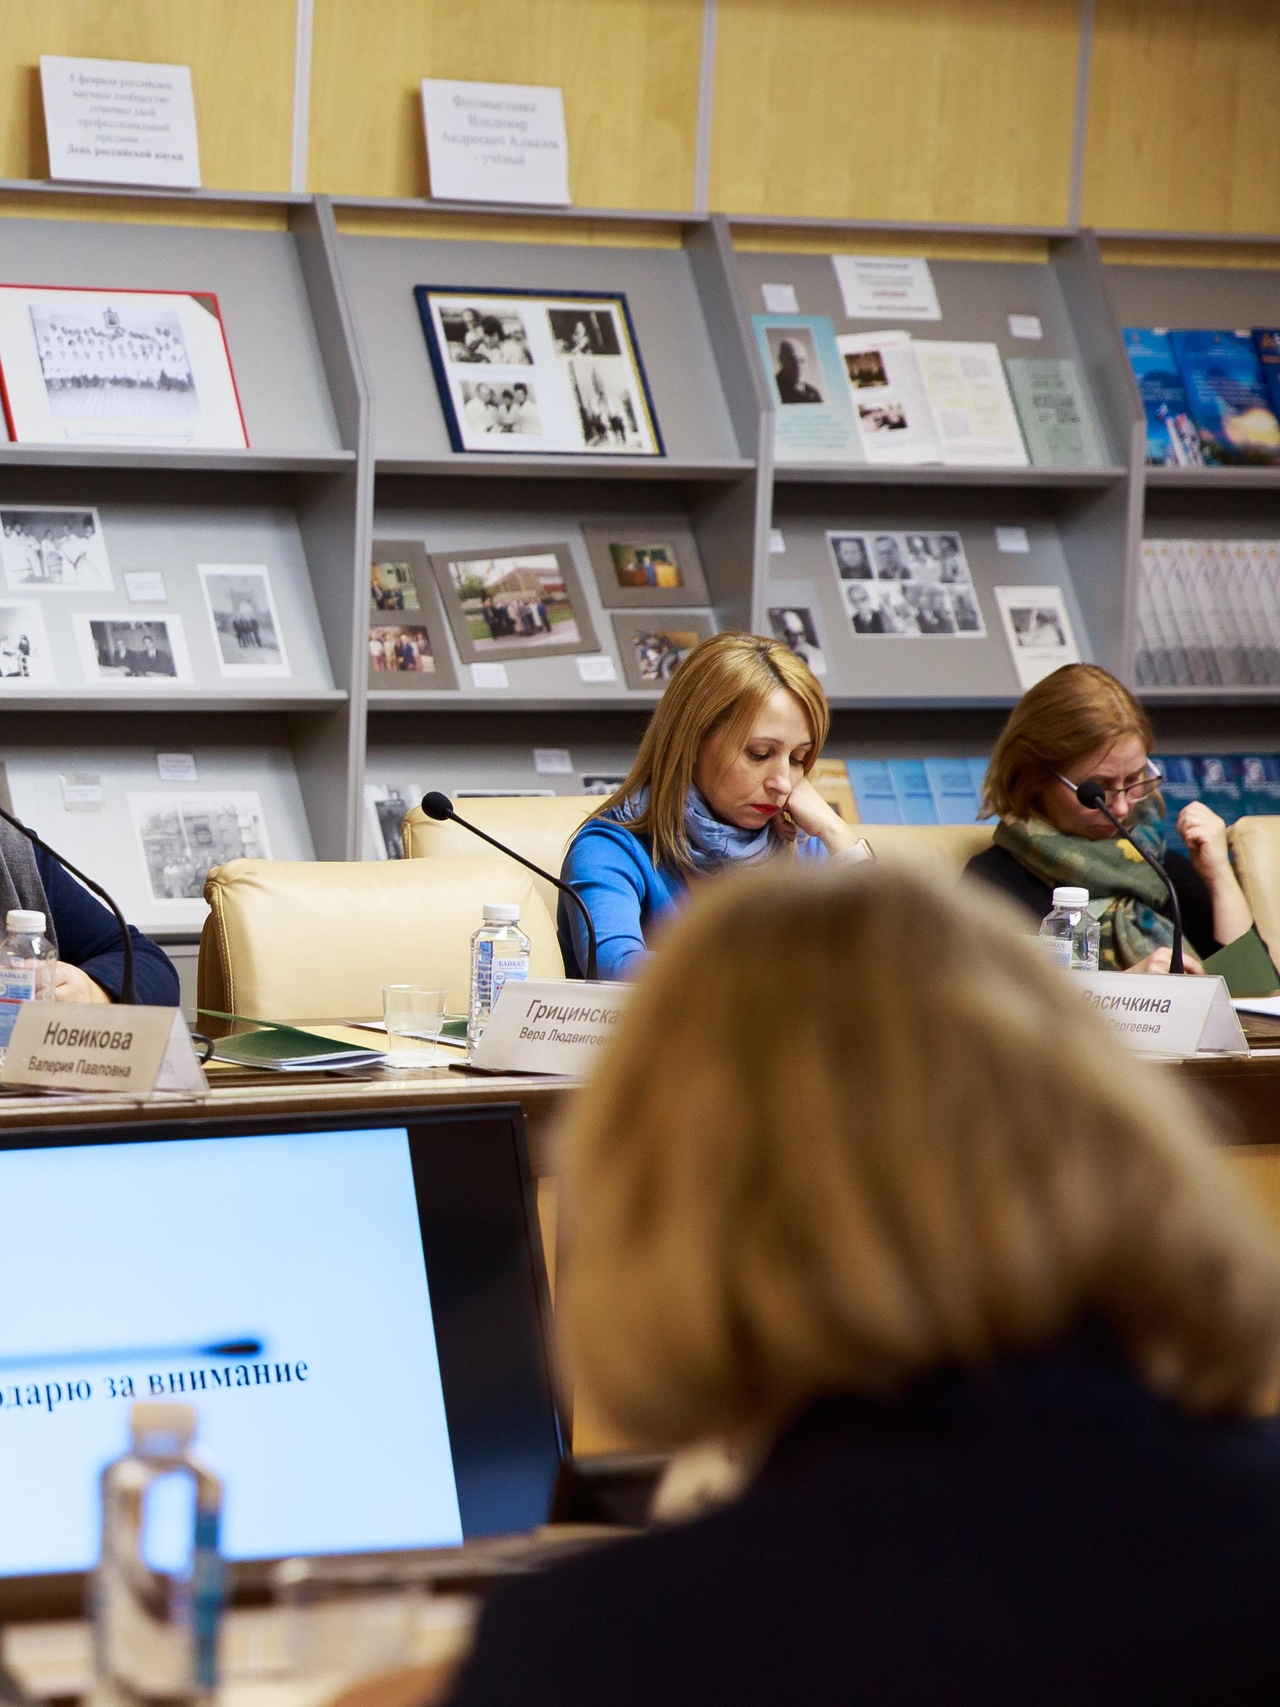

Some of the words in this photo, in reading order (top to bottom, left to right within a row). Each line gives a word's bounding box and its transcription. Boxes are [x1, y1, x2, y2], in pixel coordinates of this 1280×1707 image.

[498, 960, 525, 968] БАЙКАЛ
[526, 999, 618, 1025] Грицинска
[43, 1021, 134, 1051] Новикова
[519, 1026, 547, 1042] Вера
[28, 1056, 75, 1076] Валерия
[75, 1059, 132, 1078] Павловна
[103, 1373, 137, 1399] за
[148, 1359, 310, 1397] внимание
